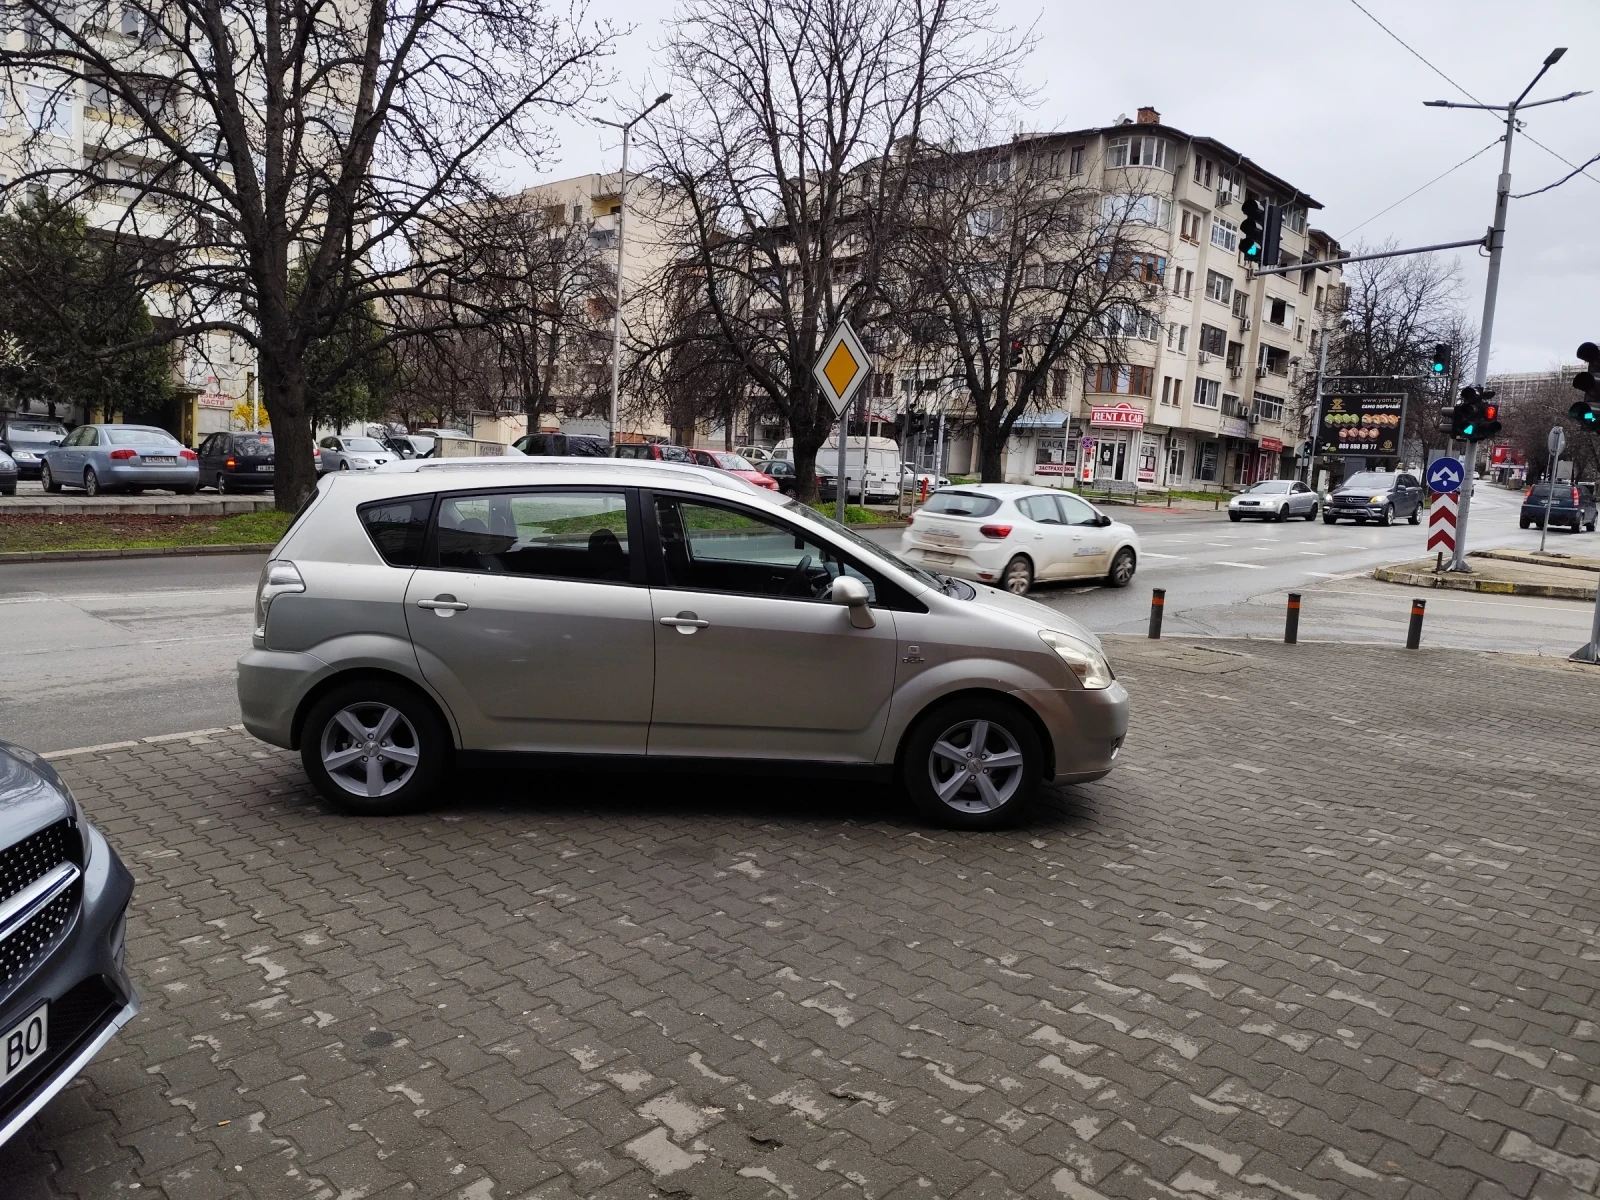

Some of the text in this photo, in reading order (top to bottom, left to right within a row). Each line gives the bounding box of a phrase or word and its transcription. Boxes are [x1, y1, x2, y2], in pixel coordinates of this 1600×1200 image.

[200, 398, 225, 406] ЧАСТИ
[1093, 411, 1143, 423] RENT A CAR
[1041, 440, 1063, 449] КАСА
[6, 1016, 43, 1076] BO
